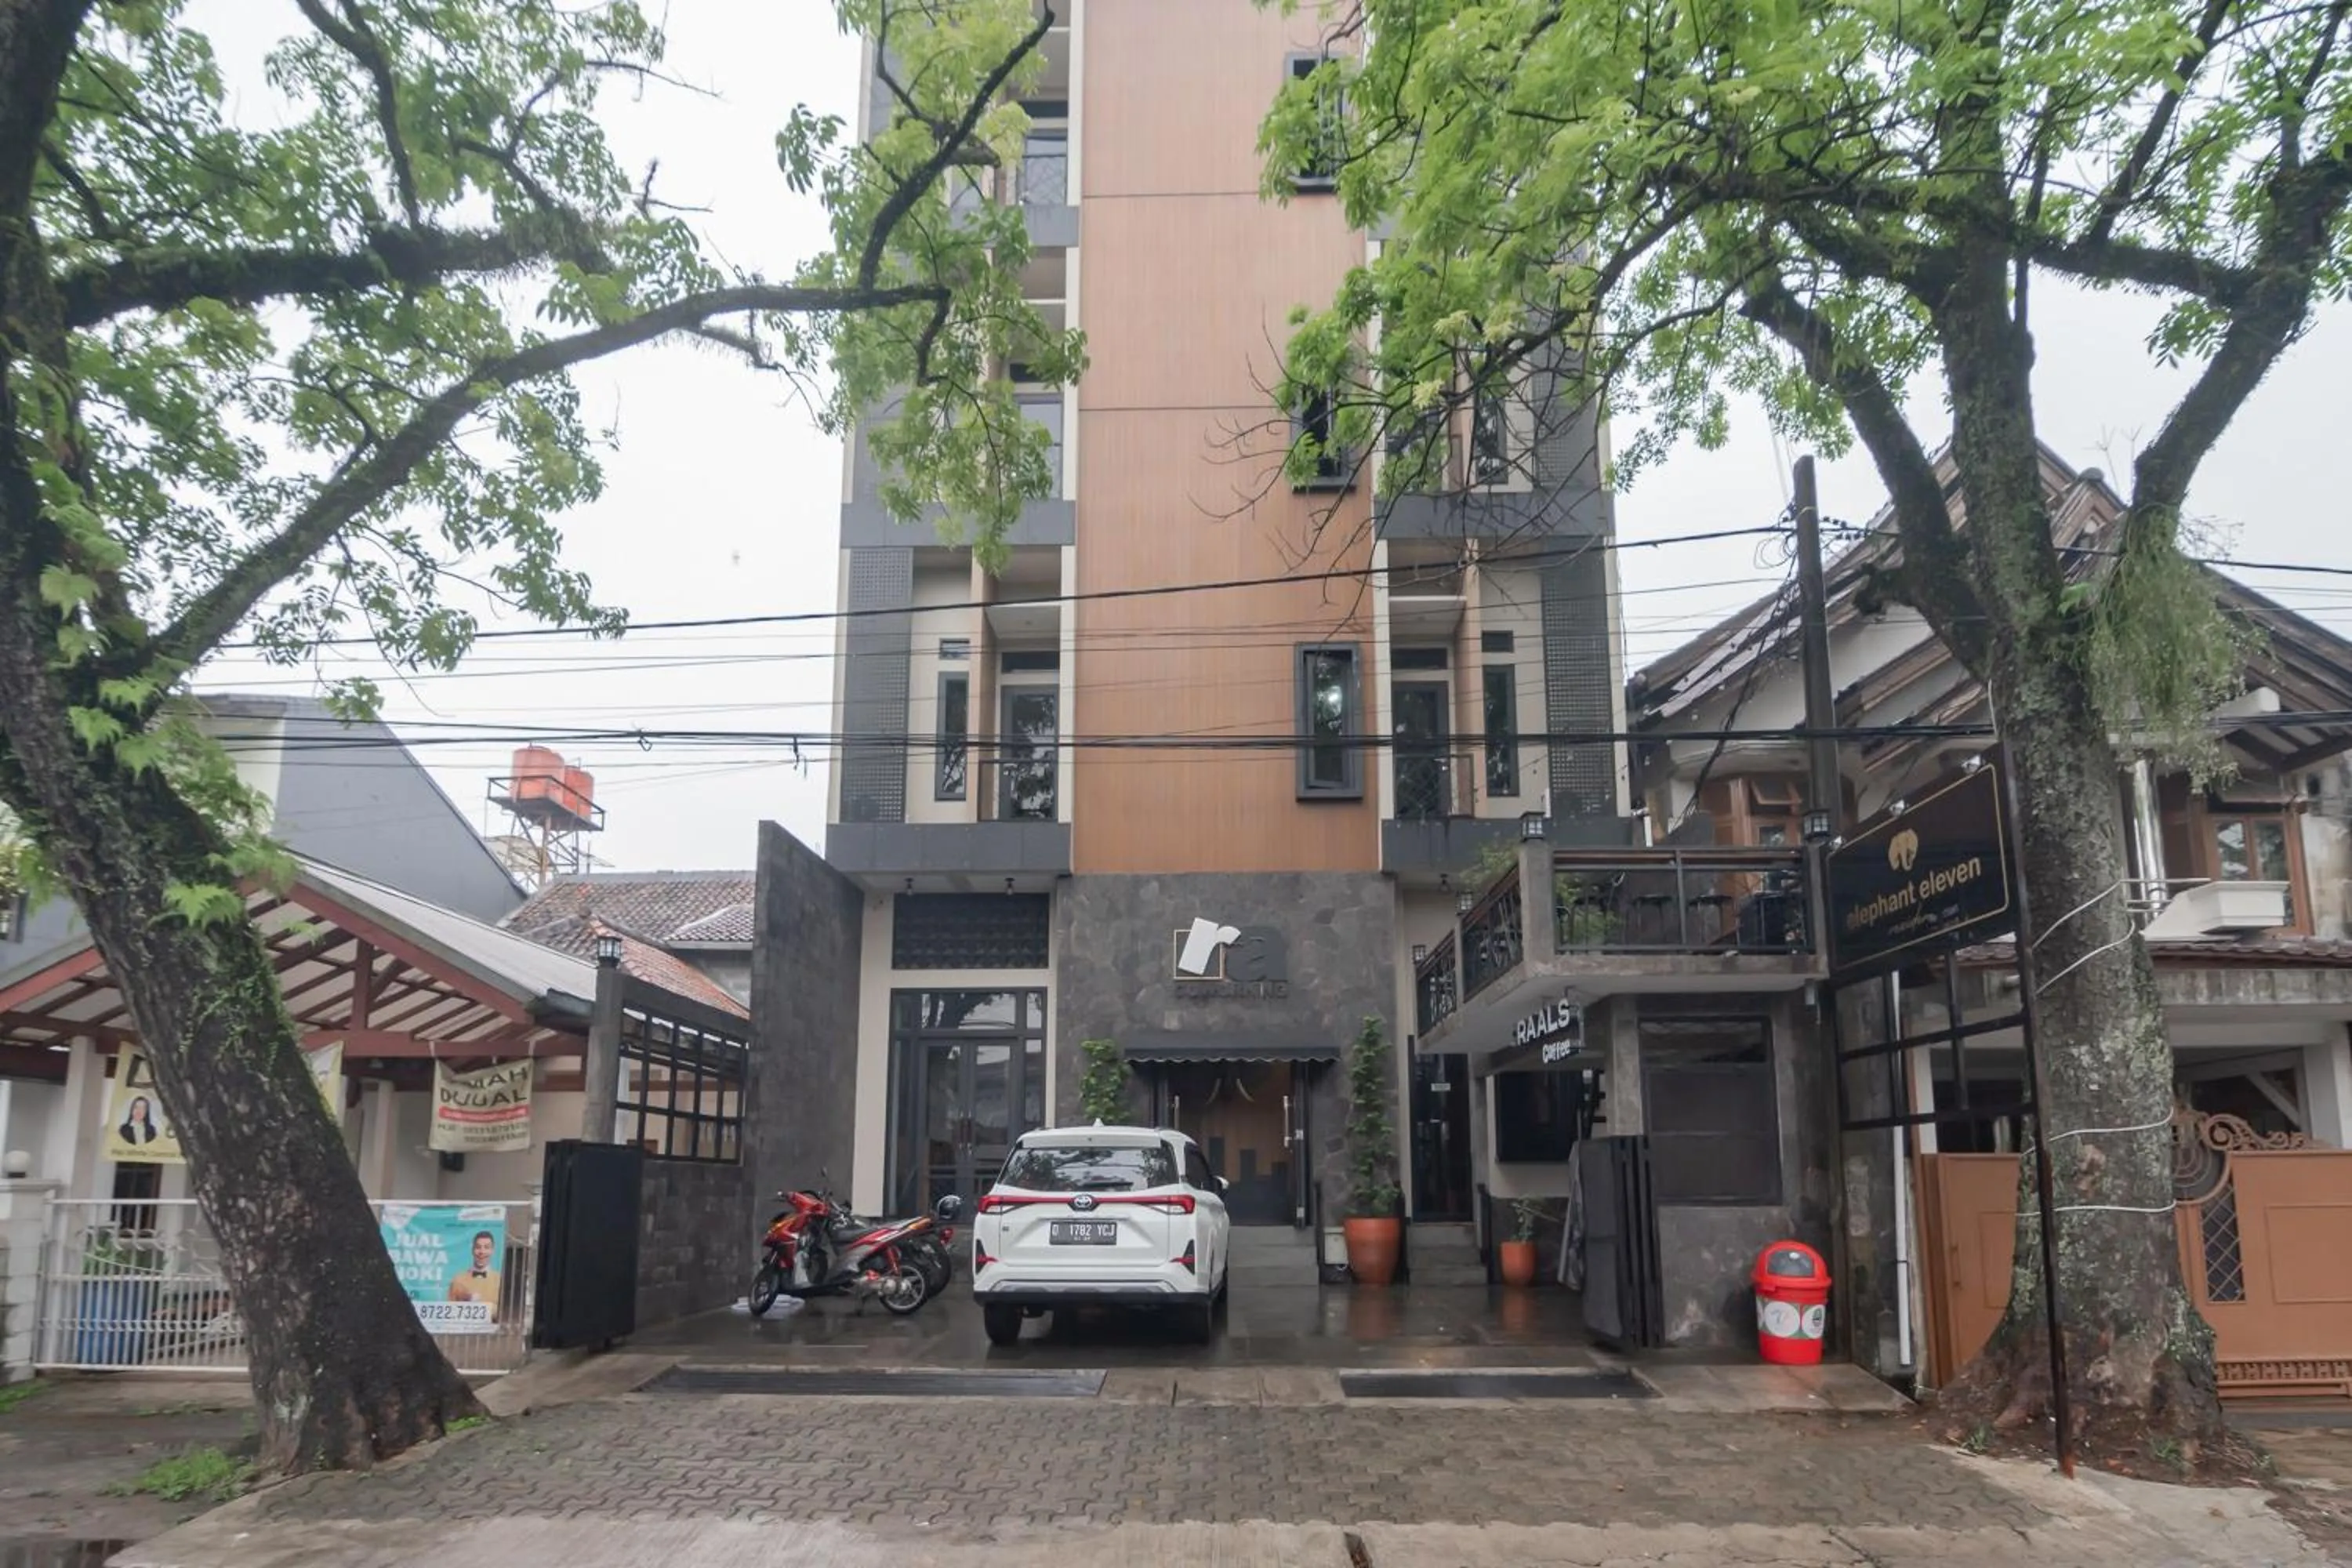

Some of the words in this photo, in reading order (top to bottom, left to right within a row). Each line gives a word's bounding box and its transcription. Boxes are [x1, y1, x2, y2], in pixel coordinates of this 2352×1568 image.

[1846, 881, 1916, 931] elephant
[1918, 856, 1981, 899] eleven
[1517, 998, 1570, 1046] RAALS
[1542, 1039, 1570, 1063] Coffee
[394, 1232, 444, 1248] JUAL
[1070, 1224, 1092, 1236] 1782
[389, 1249, 448, 1265] BAWA
